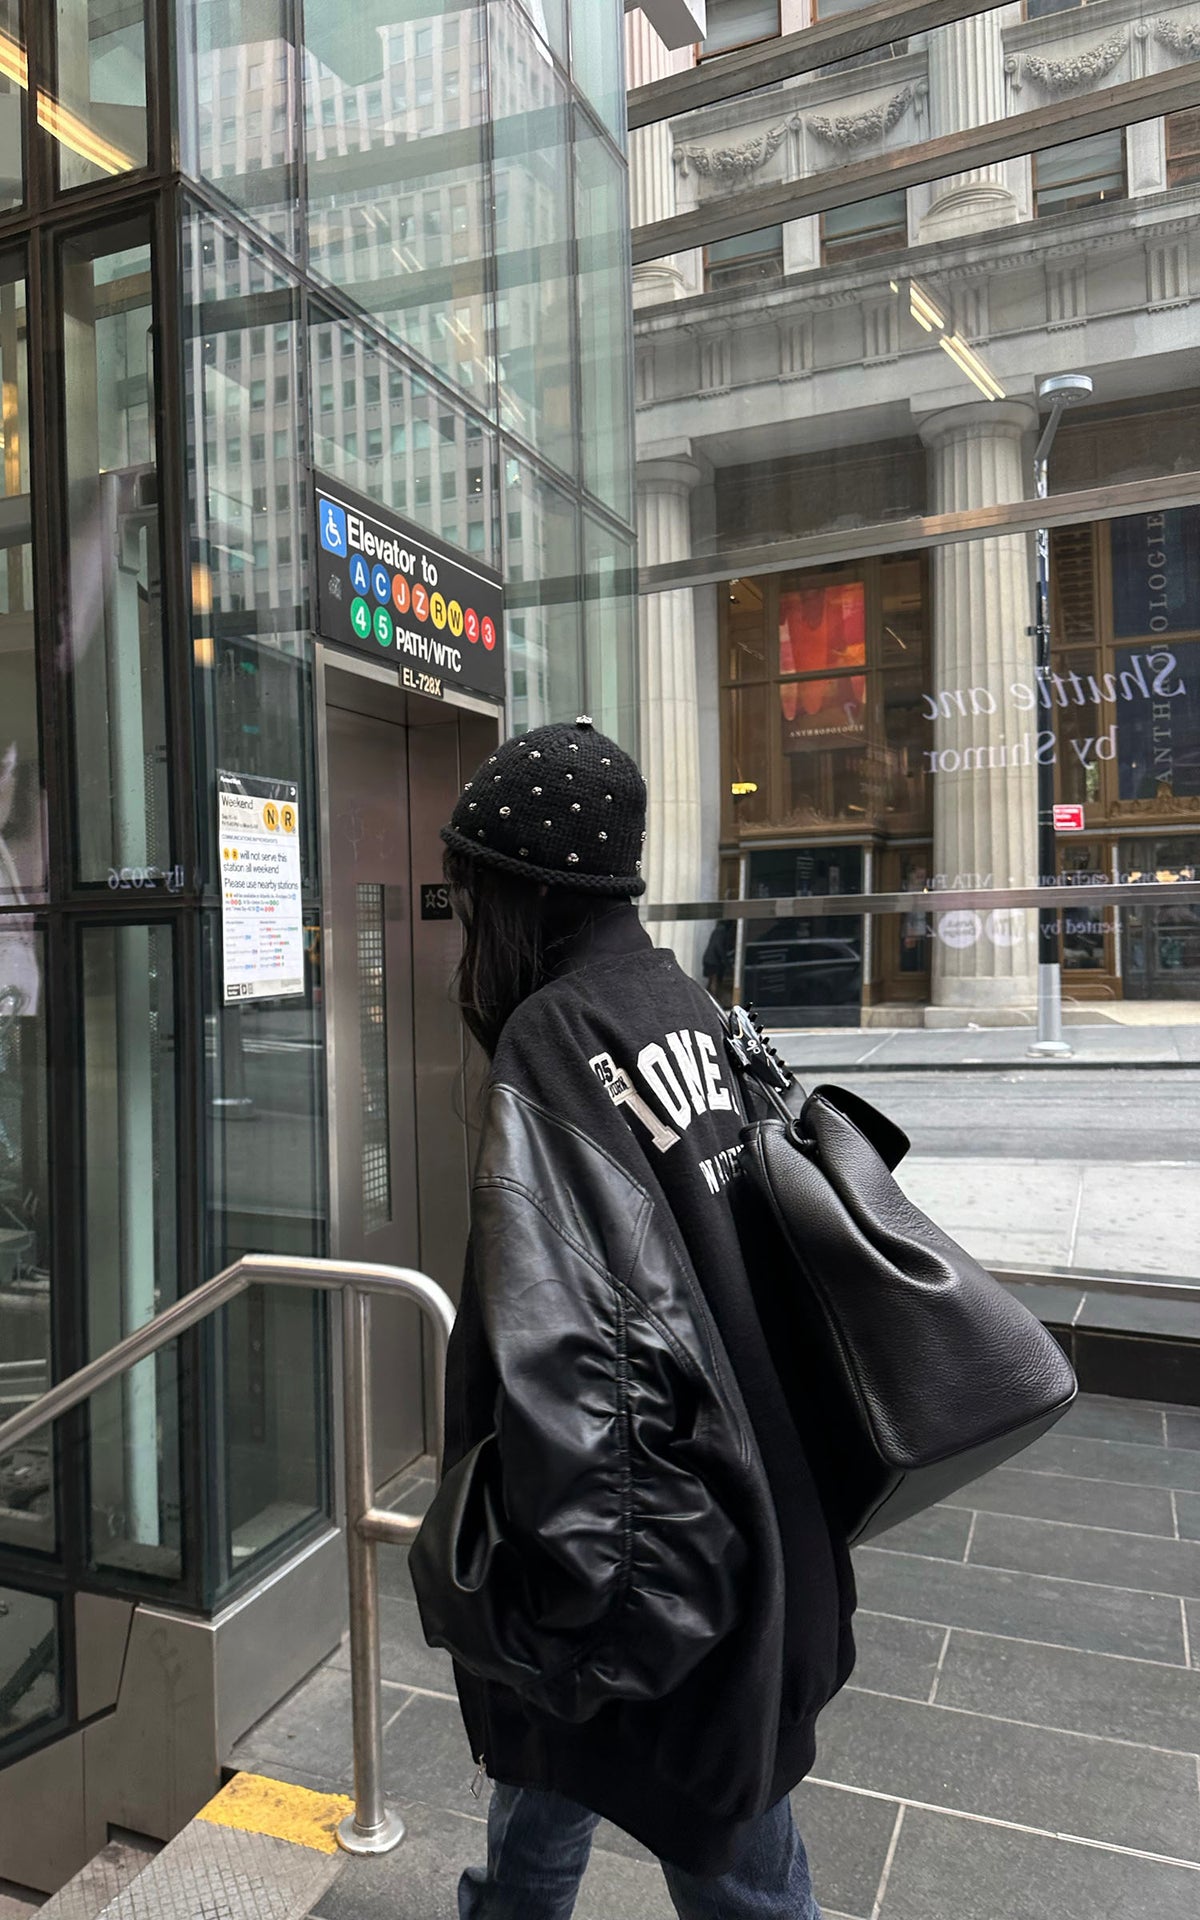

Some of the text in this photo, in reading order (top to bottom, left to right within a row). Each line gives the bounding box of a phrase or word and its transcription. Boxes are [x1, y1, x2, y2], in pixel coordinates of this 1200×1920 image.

[346, 513, 438, 587] Elevator to
[354, 561, 367, 589] A
[375, 572, 387, 597] C
[397, 583, 406, 606] J
[415, 590, 426, 616] Z
[434, 600, 444, 622] R
[450, 608, 461, 630] W
[468, 615, 476, 637] 2
[484, 623, 492, 644] 3
[355, 606, 462, 673] 4 5 PATH/WTC
[1146, 513, 1174, 786] ANTHOOLOGIE
[403, 667, 442, 697] EL-728X
[221, 794, 254, 810] Weekend
[223, 862, 245, 873] station
[253, 864, 280, 874] weekend
[240, 850, 250, 860] will
[251, 851, 261, 861] not
[278, 852, 288, 863] this
[224, 877, 299, 892] Please use nearby stations
